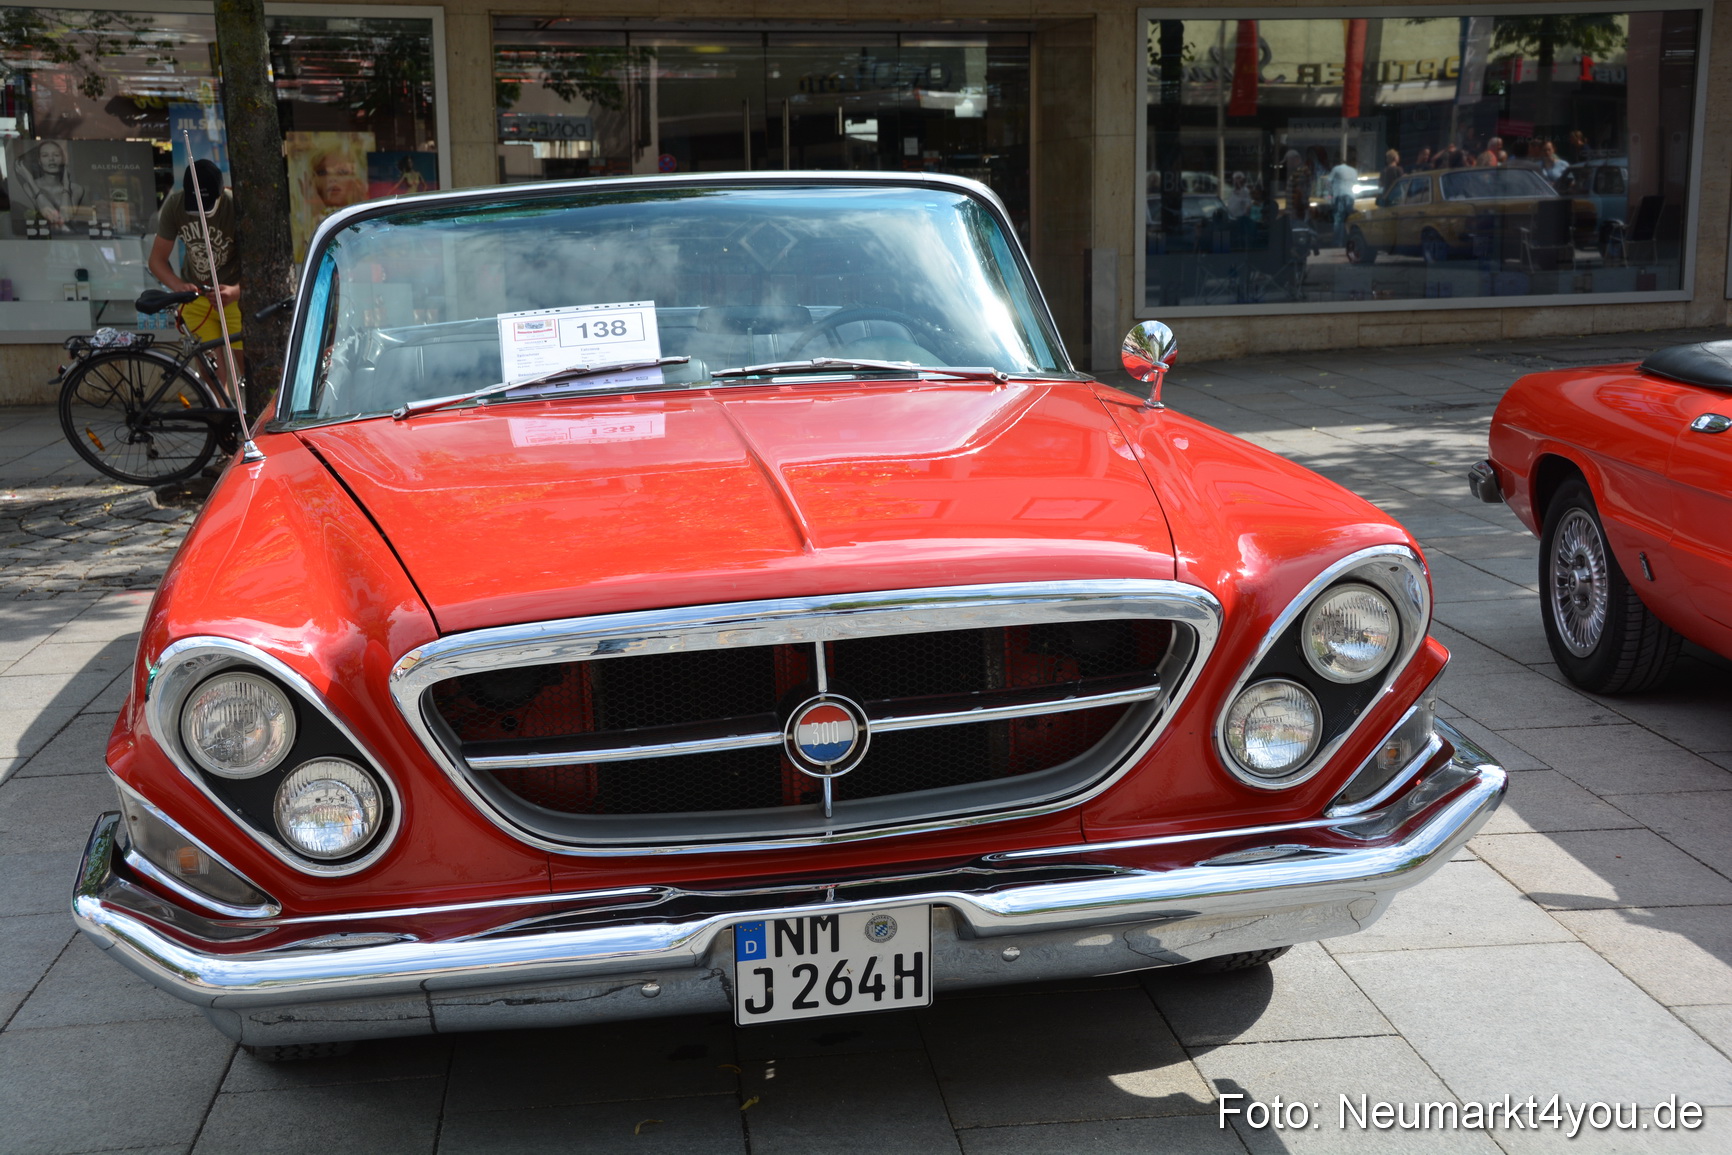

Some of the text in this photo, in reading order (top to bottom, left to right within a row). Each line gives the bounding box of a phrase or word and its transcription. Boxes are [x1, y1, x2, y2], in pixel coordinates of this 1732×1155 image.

[177, 118, 197, 131] JIL
[91, 163, 141, 171] BALENCIAGA
[577, 319, 628, 339] 138
[811, 720, 839, 746] 300
[775, 914, 840, 957] NM
[745, 941, 758, 954] D
[745, 952, 923, 1014] J 264H
